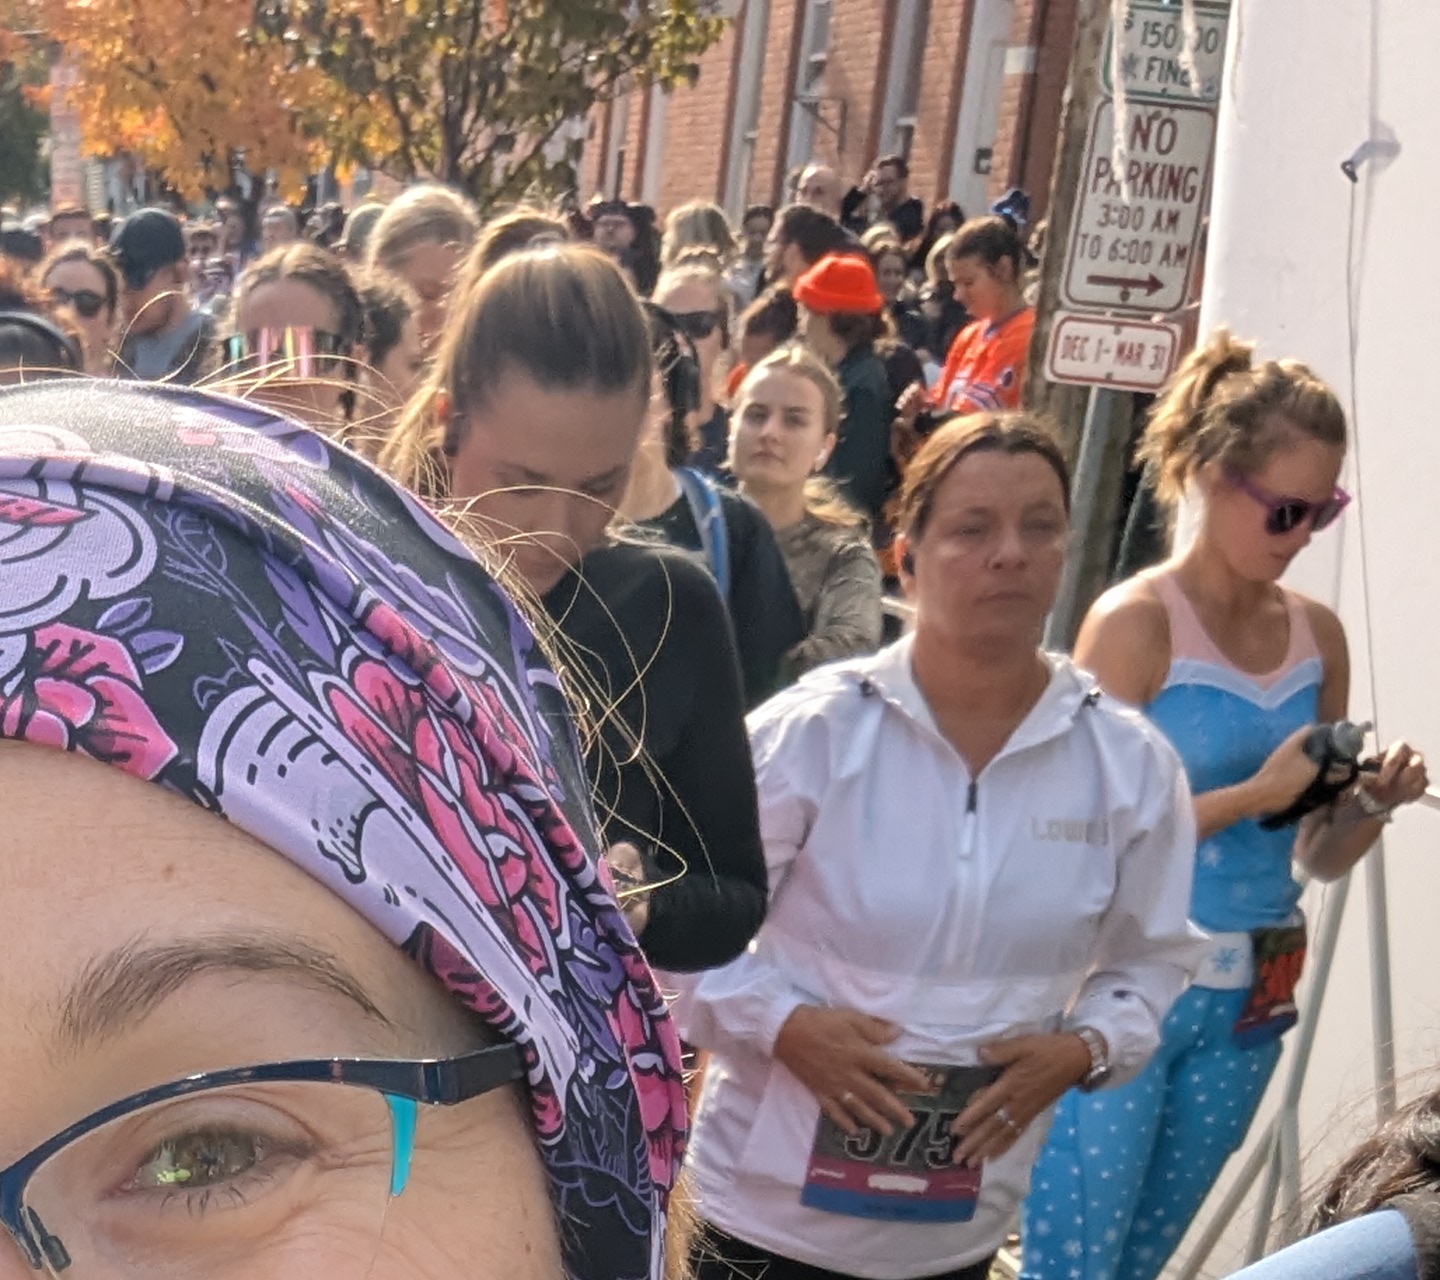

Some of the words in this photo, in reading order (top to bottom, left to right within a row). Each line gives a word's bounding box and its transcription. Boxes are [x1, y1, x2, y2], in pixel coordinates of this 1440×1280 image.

[1131, 113, 1179, 156] NO
[1091, 157, 1199, 203] PARKING
[1097, 203, 1145, 231] 3:00
[1151, 209, 1180, 234] AM
[1079, 232, 1102, 260] TO
[1108, 237, 1153, 265] 6:00
[1159, 242, 1188, 268] AM
[1061, 335, 1090, 362] DEC
[1113, 341, 1145, 367] MAR
[1149, 344, 1167, 371] 31
